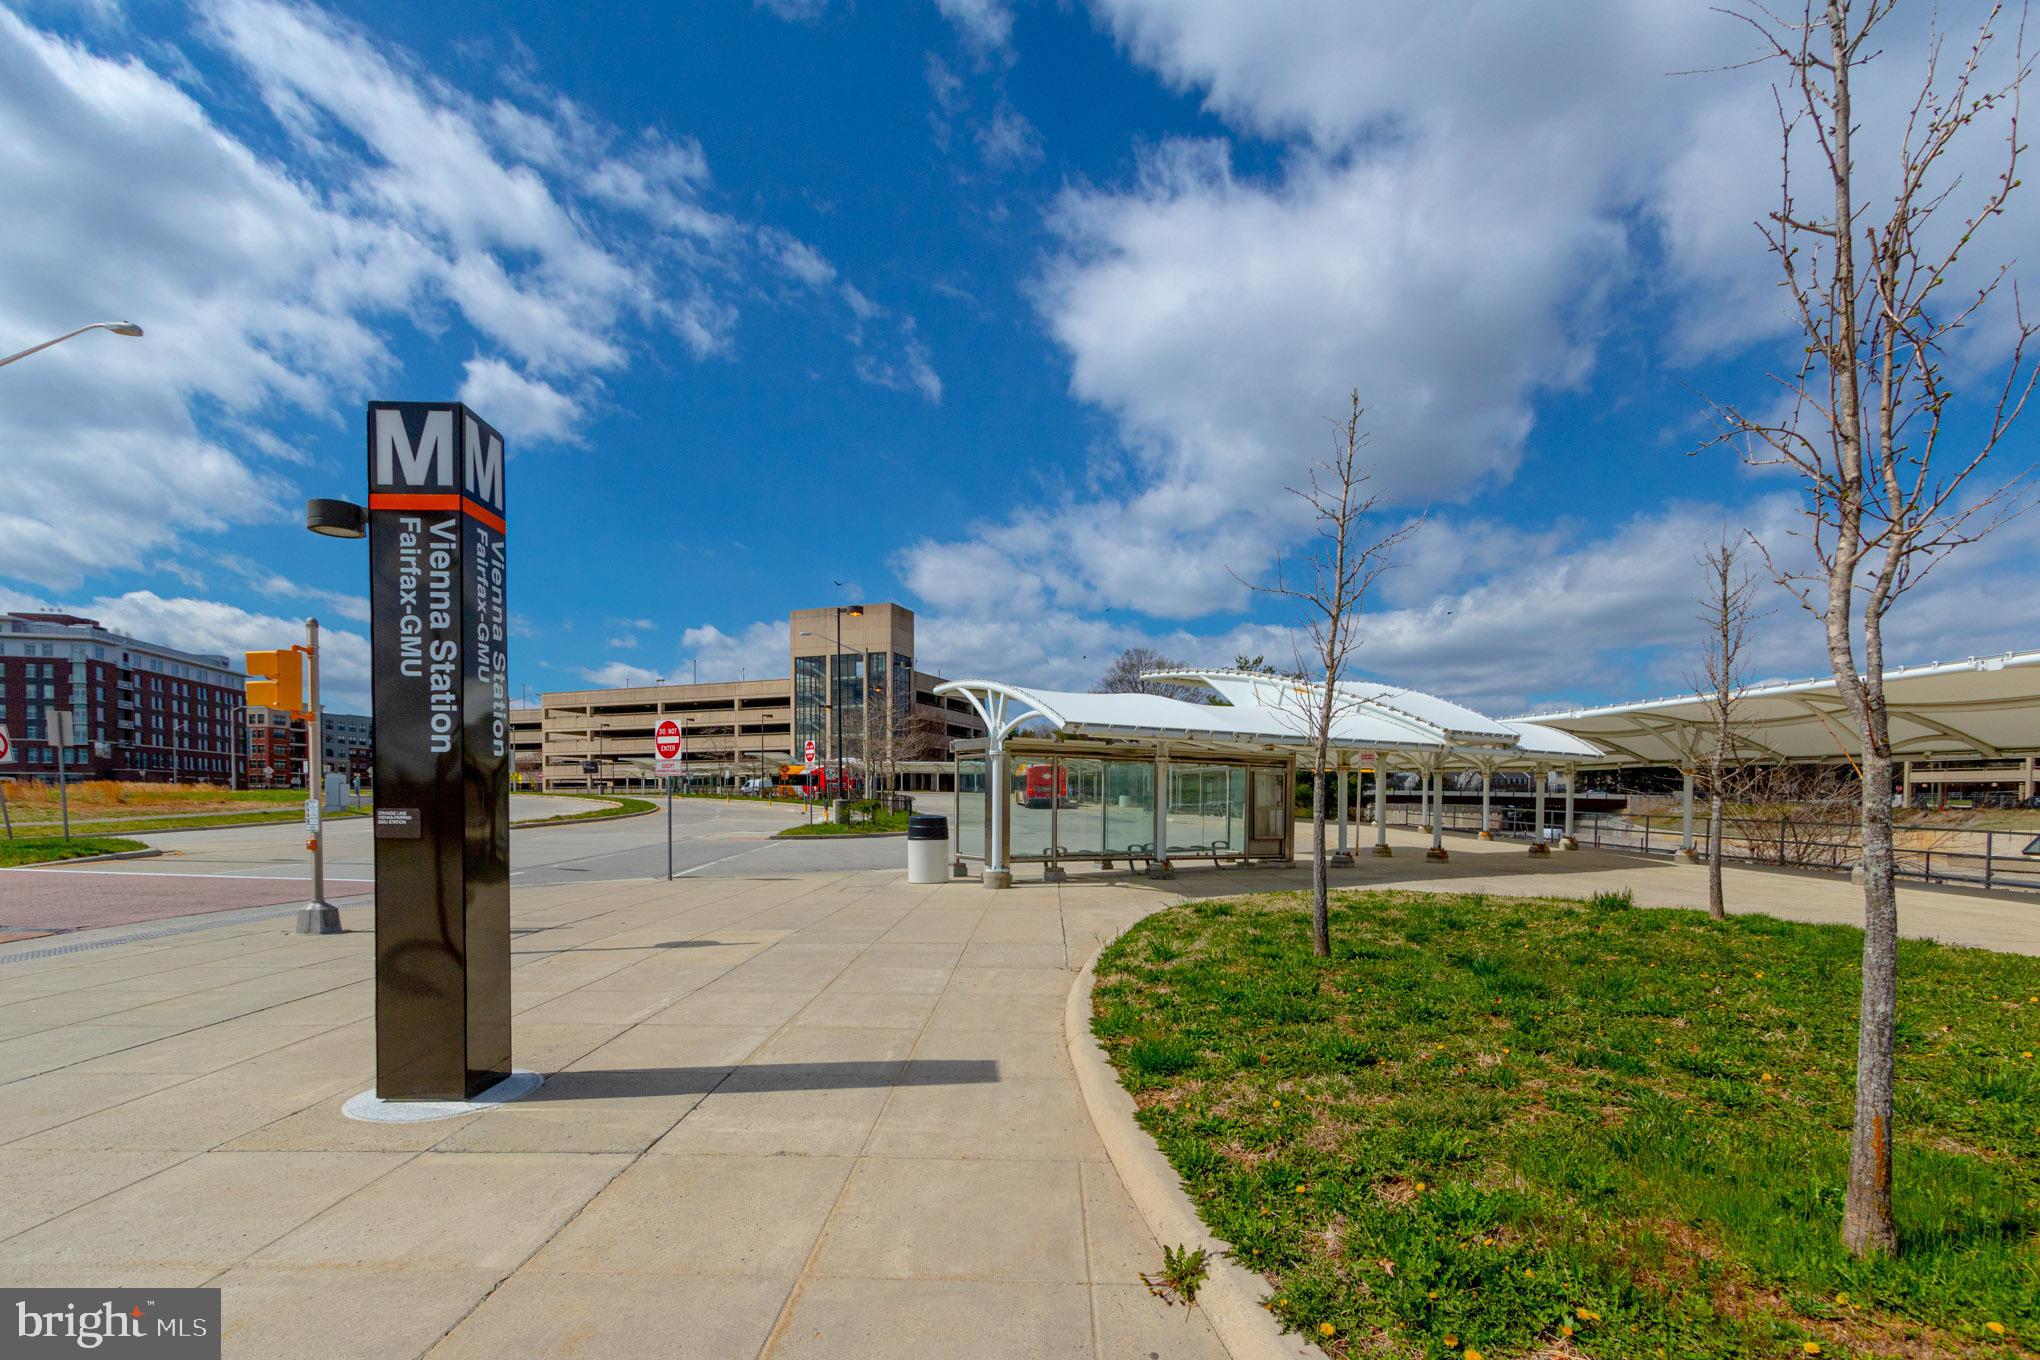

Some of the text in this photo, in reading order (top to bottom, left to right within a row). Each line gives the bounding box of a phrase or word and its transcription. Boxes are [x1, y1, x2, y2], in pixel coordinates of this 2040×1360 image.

[375, 409, 454, 486] M
[465, 415, 503, 511] M
[399, 517, 423, 677] Fairfax-GMU
[429, 518, 458, 753] Vienna Station
[476, 527, 490, 684] Fairfax-GMU
[491, 541, 507, 757] Vienna Station
